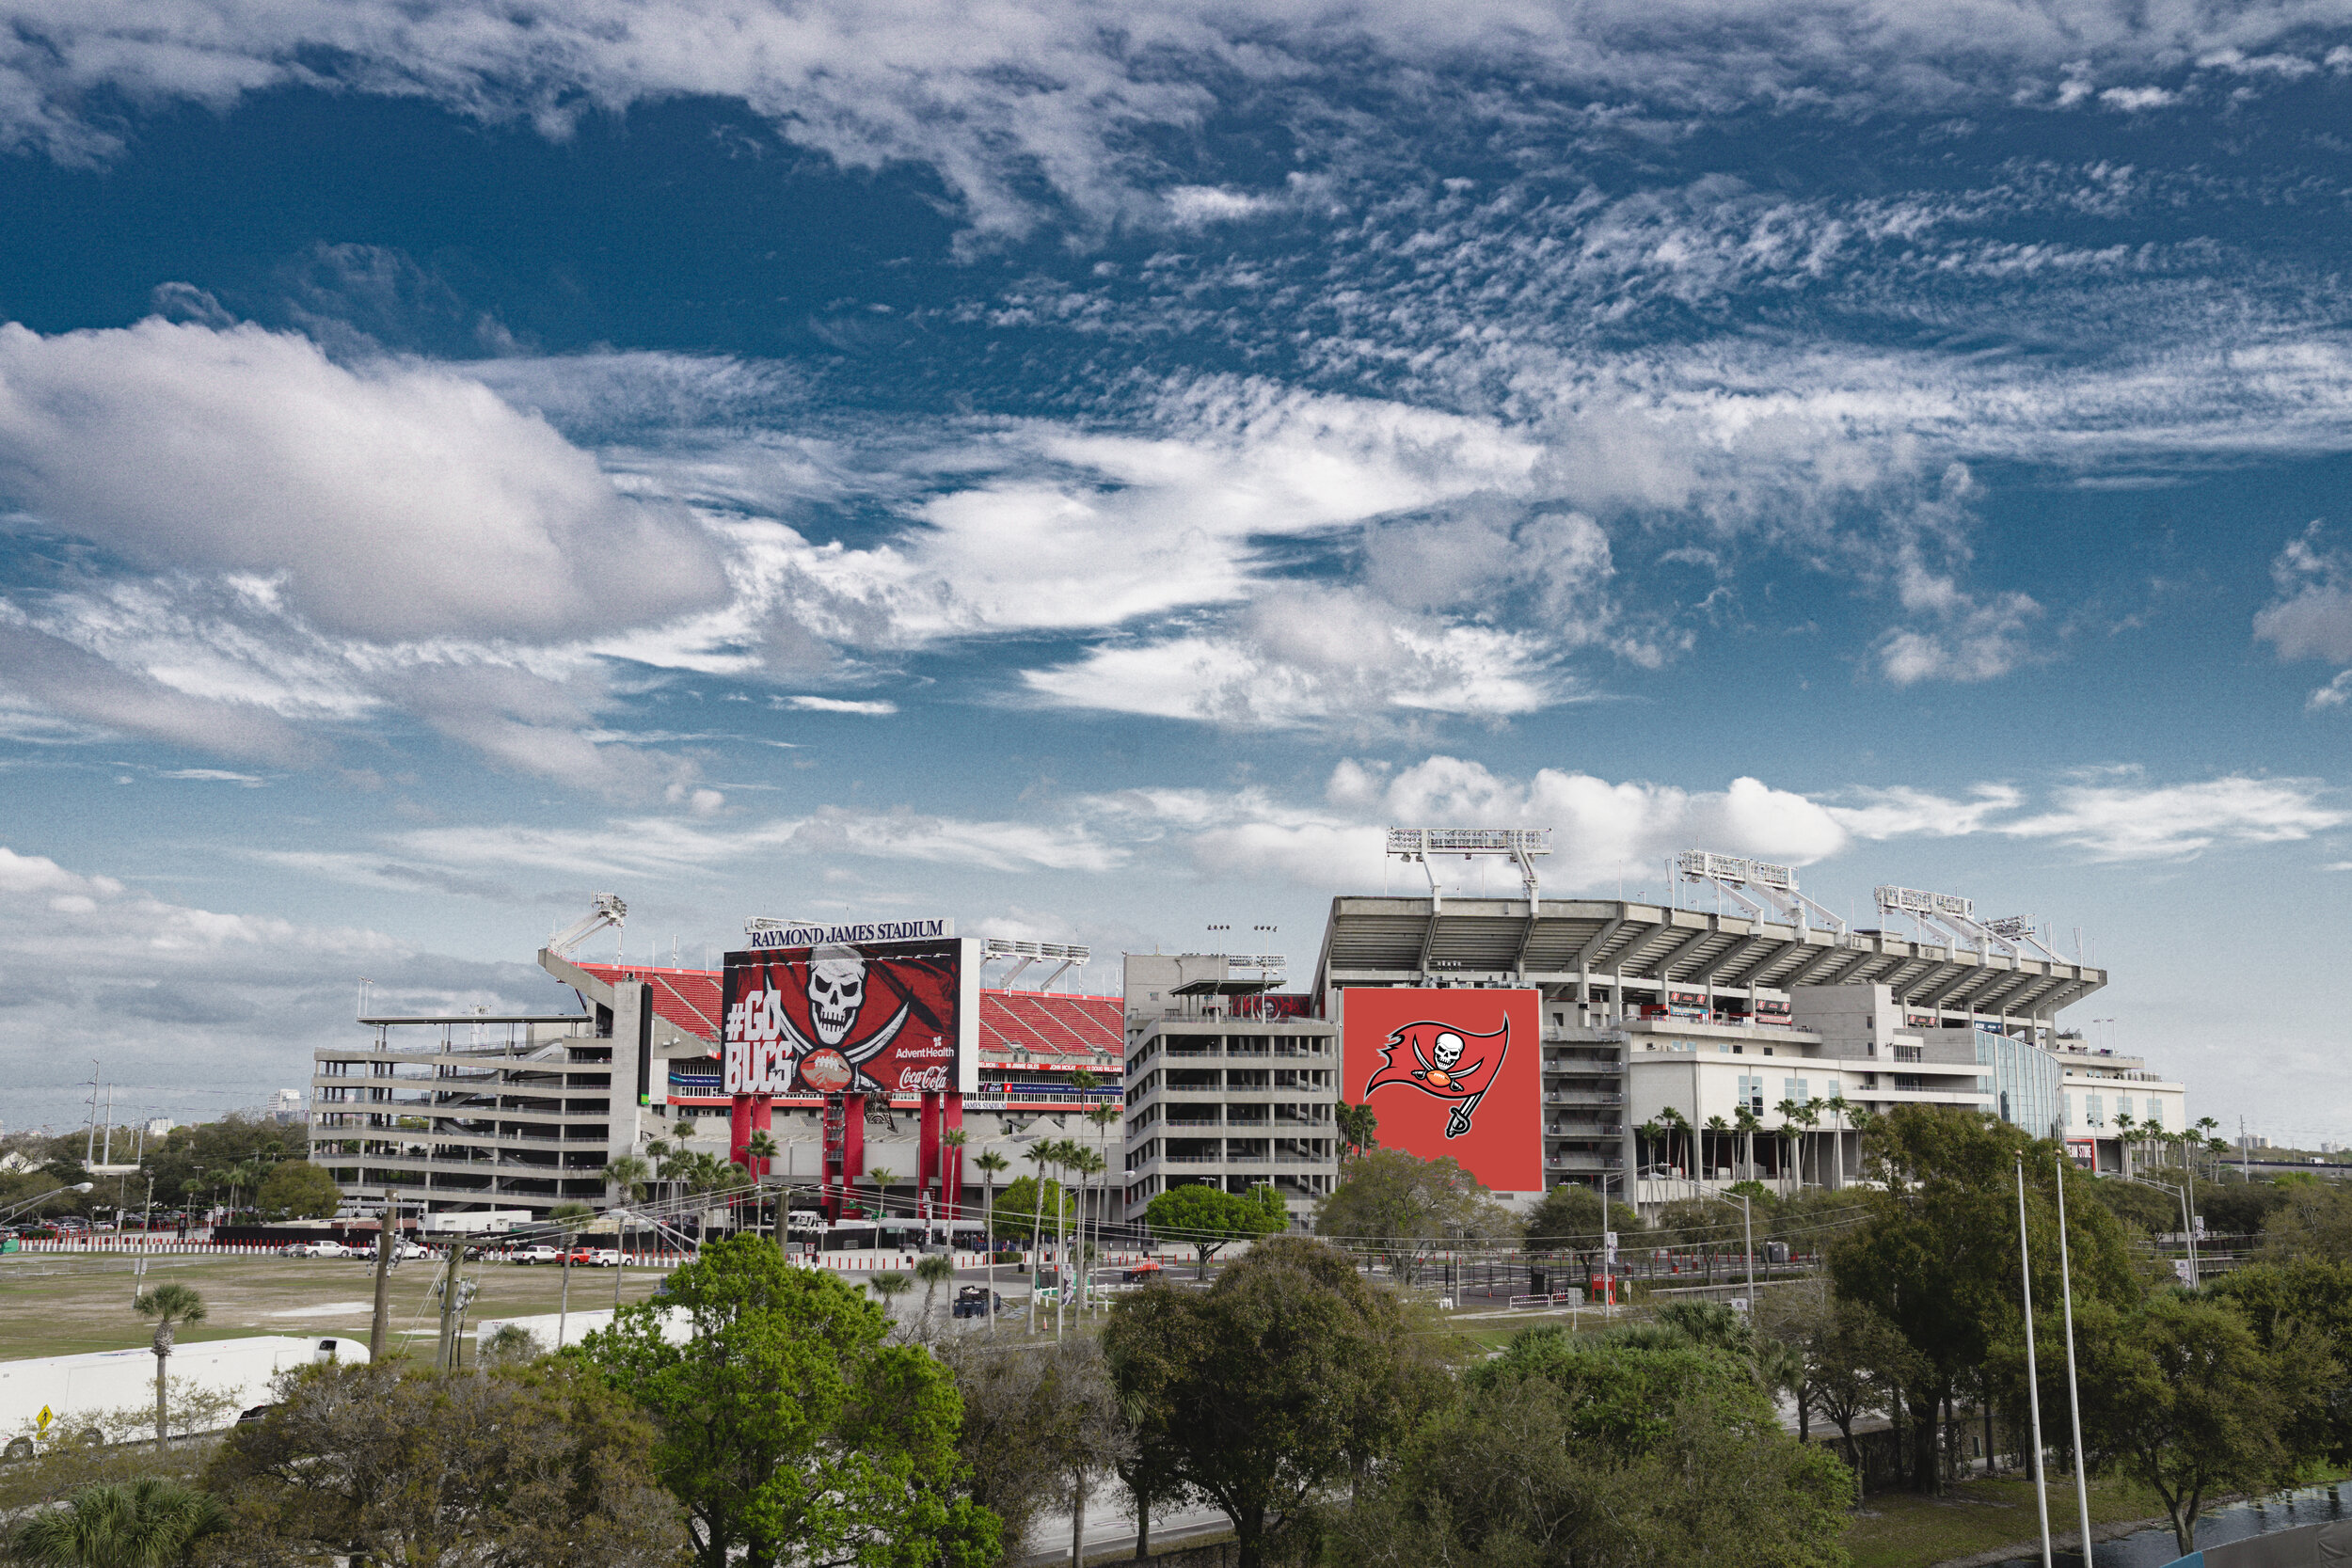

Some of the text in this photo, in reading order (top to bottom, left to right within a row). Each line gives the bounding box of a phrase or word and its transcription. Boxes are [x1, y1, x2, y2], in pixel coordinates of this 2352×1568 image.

[752, 919, 944, 947] RAYMOND JAMES STADIUM
[725, 990, 781, 1041] #GO
[724, 1040, 793, 1093] BUCS
[896, 1046, 955, 1059] AdventHealth
